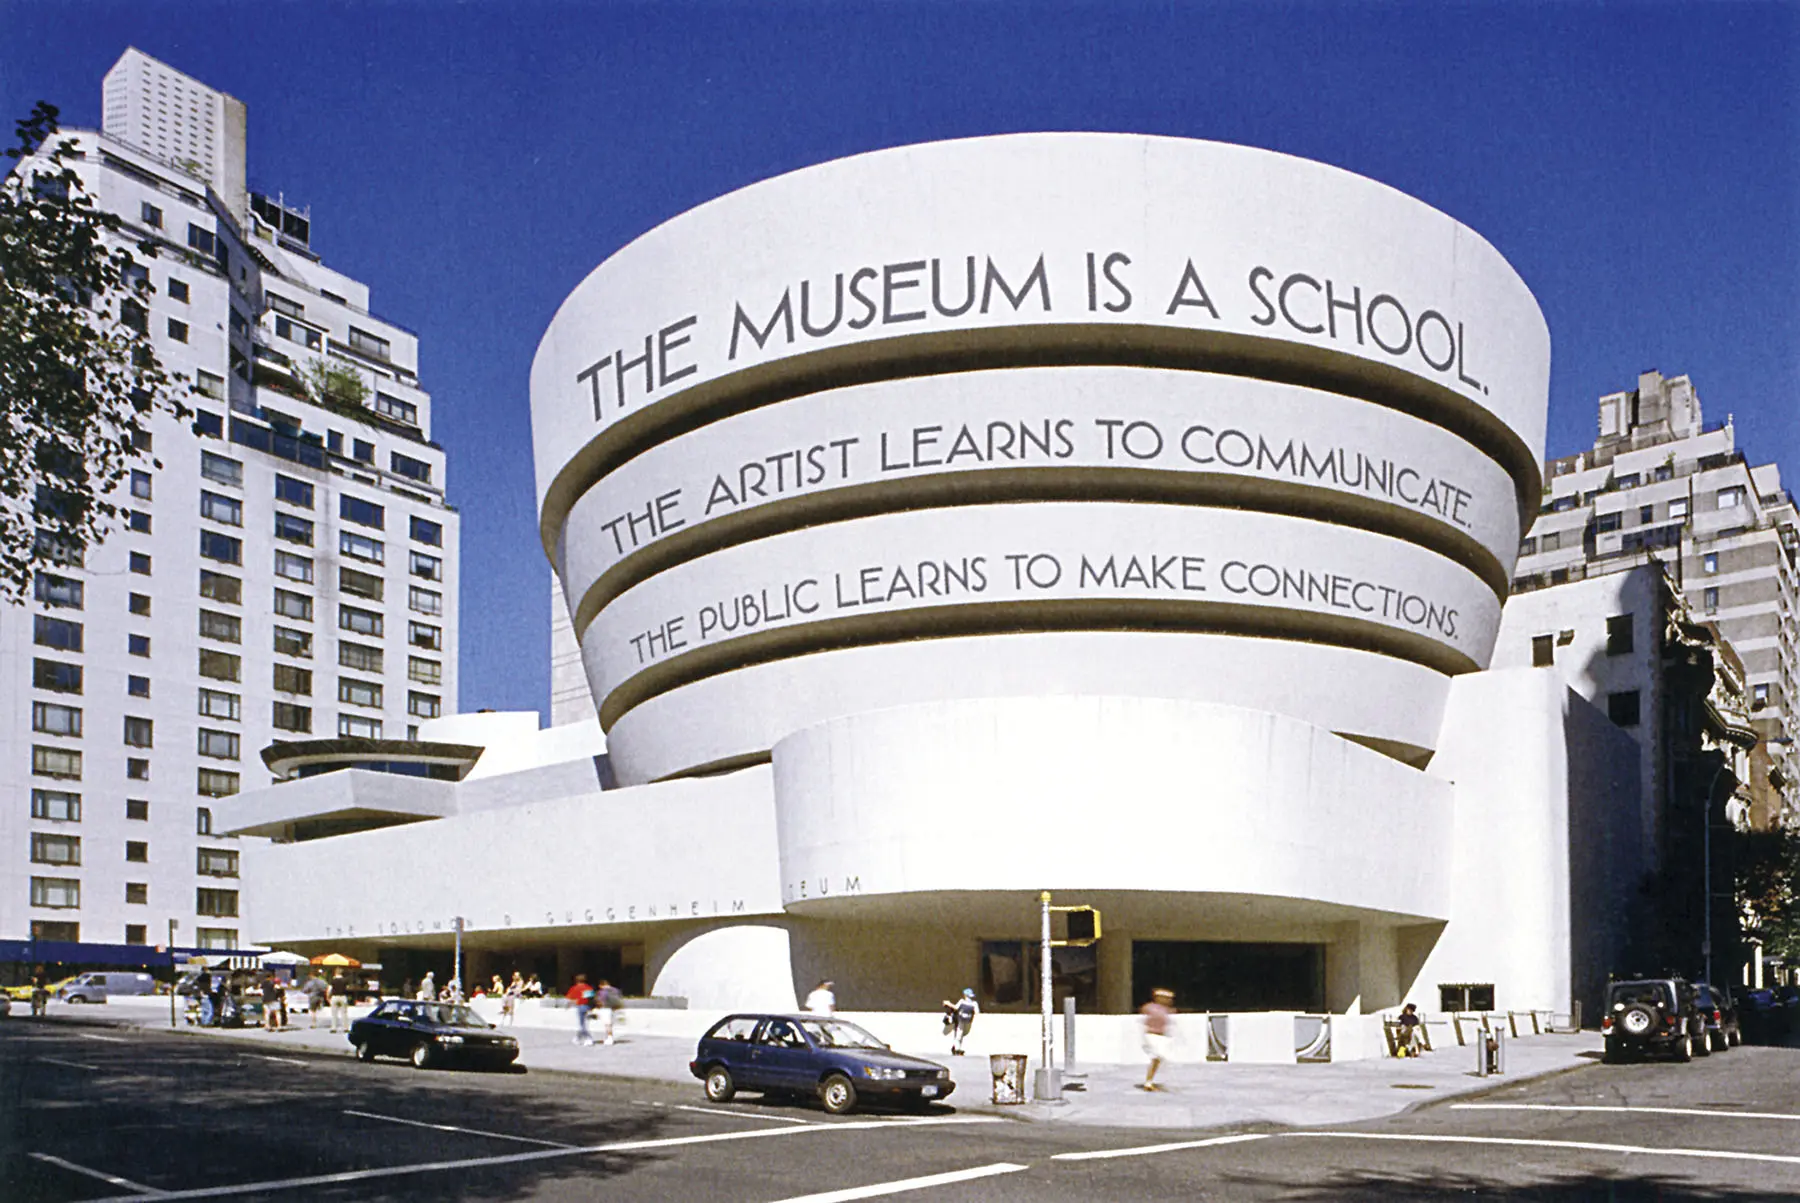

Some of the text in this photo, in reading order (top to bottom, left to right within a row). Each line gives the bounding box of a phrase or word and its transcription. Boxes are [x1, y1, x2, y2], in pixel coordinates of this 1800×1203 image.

[577, 253, 1488, 422] THE MUSEUM IS A SCHOOL.
[601, 419, 1472, 554] THE ARTIST LEARNS TO COMMUNICATE.
[630, 554, 1459, 663] THE PUBLIC LEARNS TO MAKE CONNECTIONS.
[546, 899, 746, 925] GUGGENHEIM
